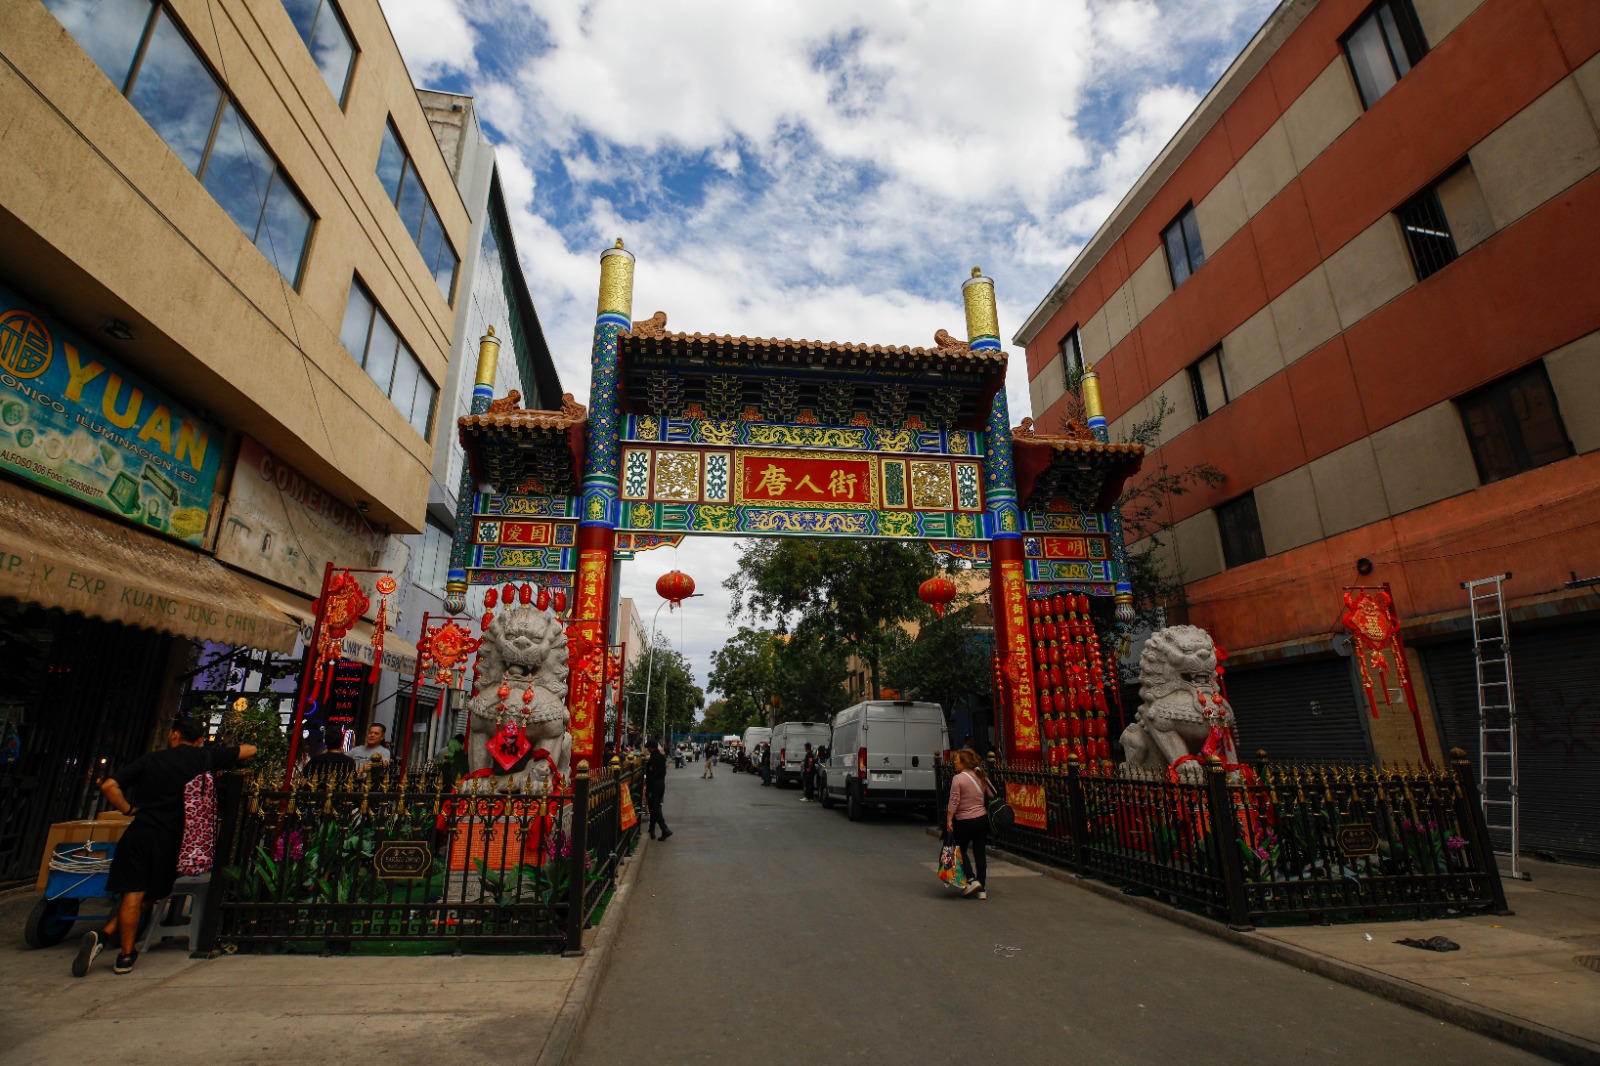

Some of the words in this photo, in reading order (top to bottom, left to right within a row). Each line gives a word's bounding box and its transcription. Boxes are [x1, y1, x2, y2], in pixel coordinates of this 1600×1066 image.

[63, 341, 209, 472] YUAN
[75, 413, 173, 471] ILUMINACION
[174, 466, 198, 484] LED
[32, 462, 46, 475] 306
[753, 463, 858, 499] 唐人街
[259, 455, 369, 538] COMERCIAL
[506, 524, 546, 543] 爱国
[1048, 539, 1084, 556] 文明
[43, 563, 55, 581] Y
[67, 571, 107, 597] EXP.
[120, 586, 179, 616] KUANG
[183, 605, 218, 626] JUNG
[225, 614, 257, 633] CHEN
[336, 701, 352, 709] BAR
